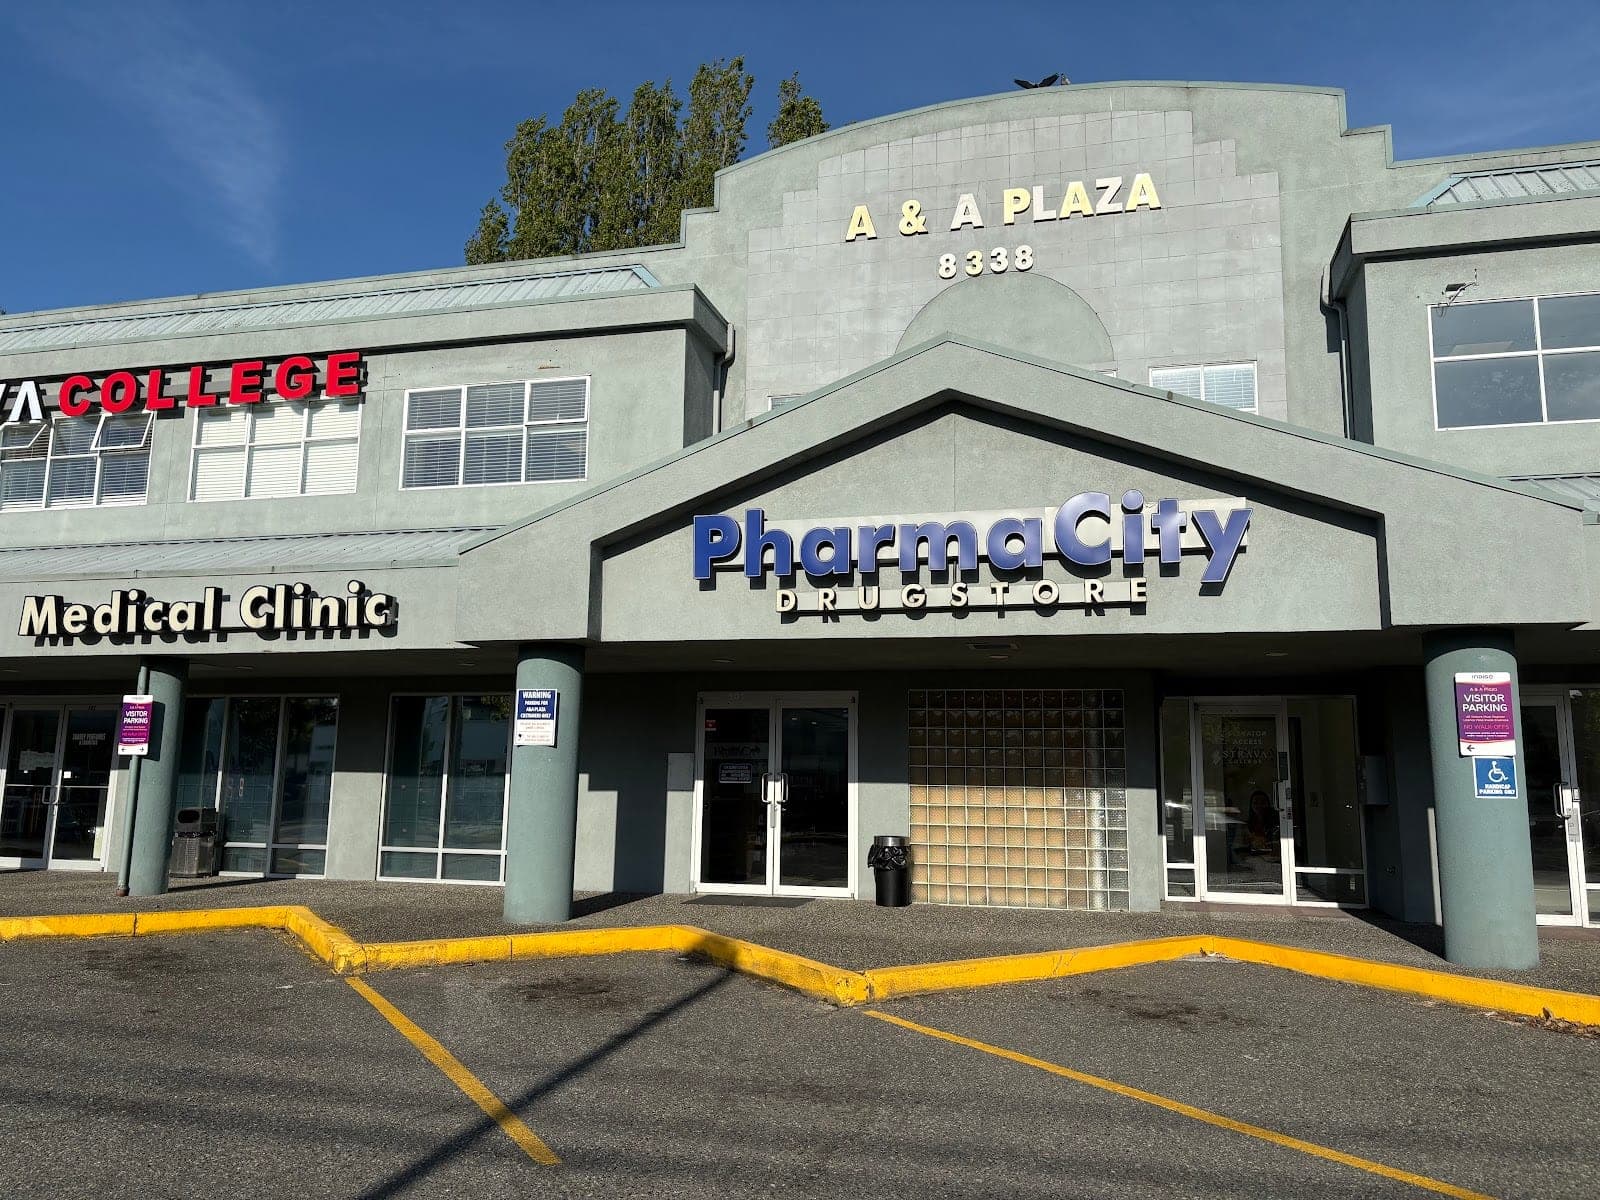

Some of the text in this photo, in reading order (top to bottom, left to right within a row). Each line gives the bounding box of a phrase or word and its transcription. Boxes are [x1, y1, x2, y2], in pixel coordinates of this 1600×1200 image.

[845, 172, 1162, 242] A & A PLAZA
[938, 244, 1035, 280] 8338
[0, 351, 363, 422] A COLLEGE
[693, 489, 1254, 585] PharmaCity
[18, 579, 397, 638] Medical Clinic
[776, 577, 1148, 615] DRUGSTORE
[522, 691, 552, 699] WARNING
[1462, 703, 1508, 712] PARKING
[1463, 693, 1505, 702] VISITOR
